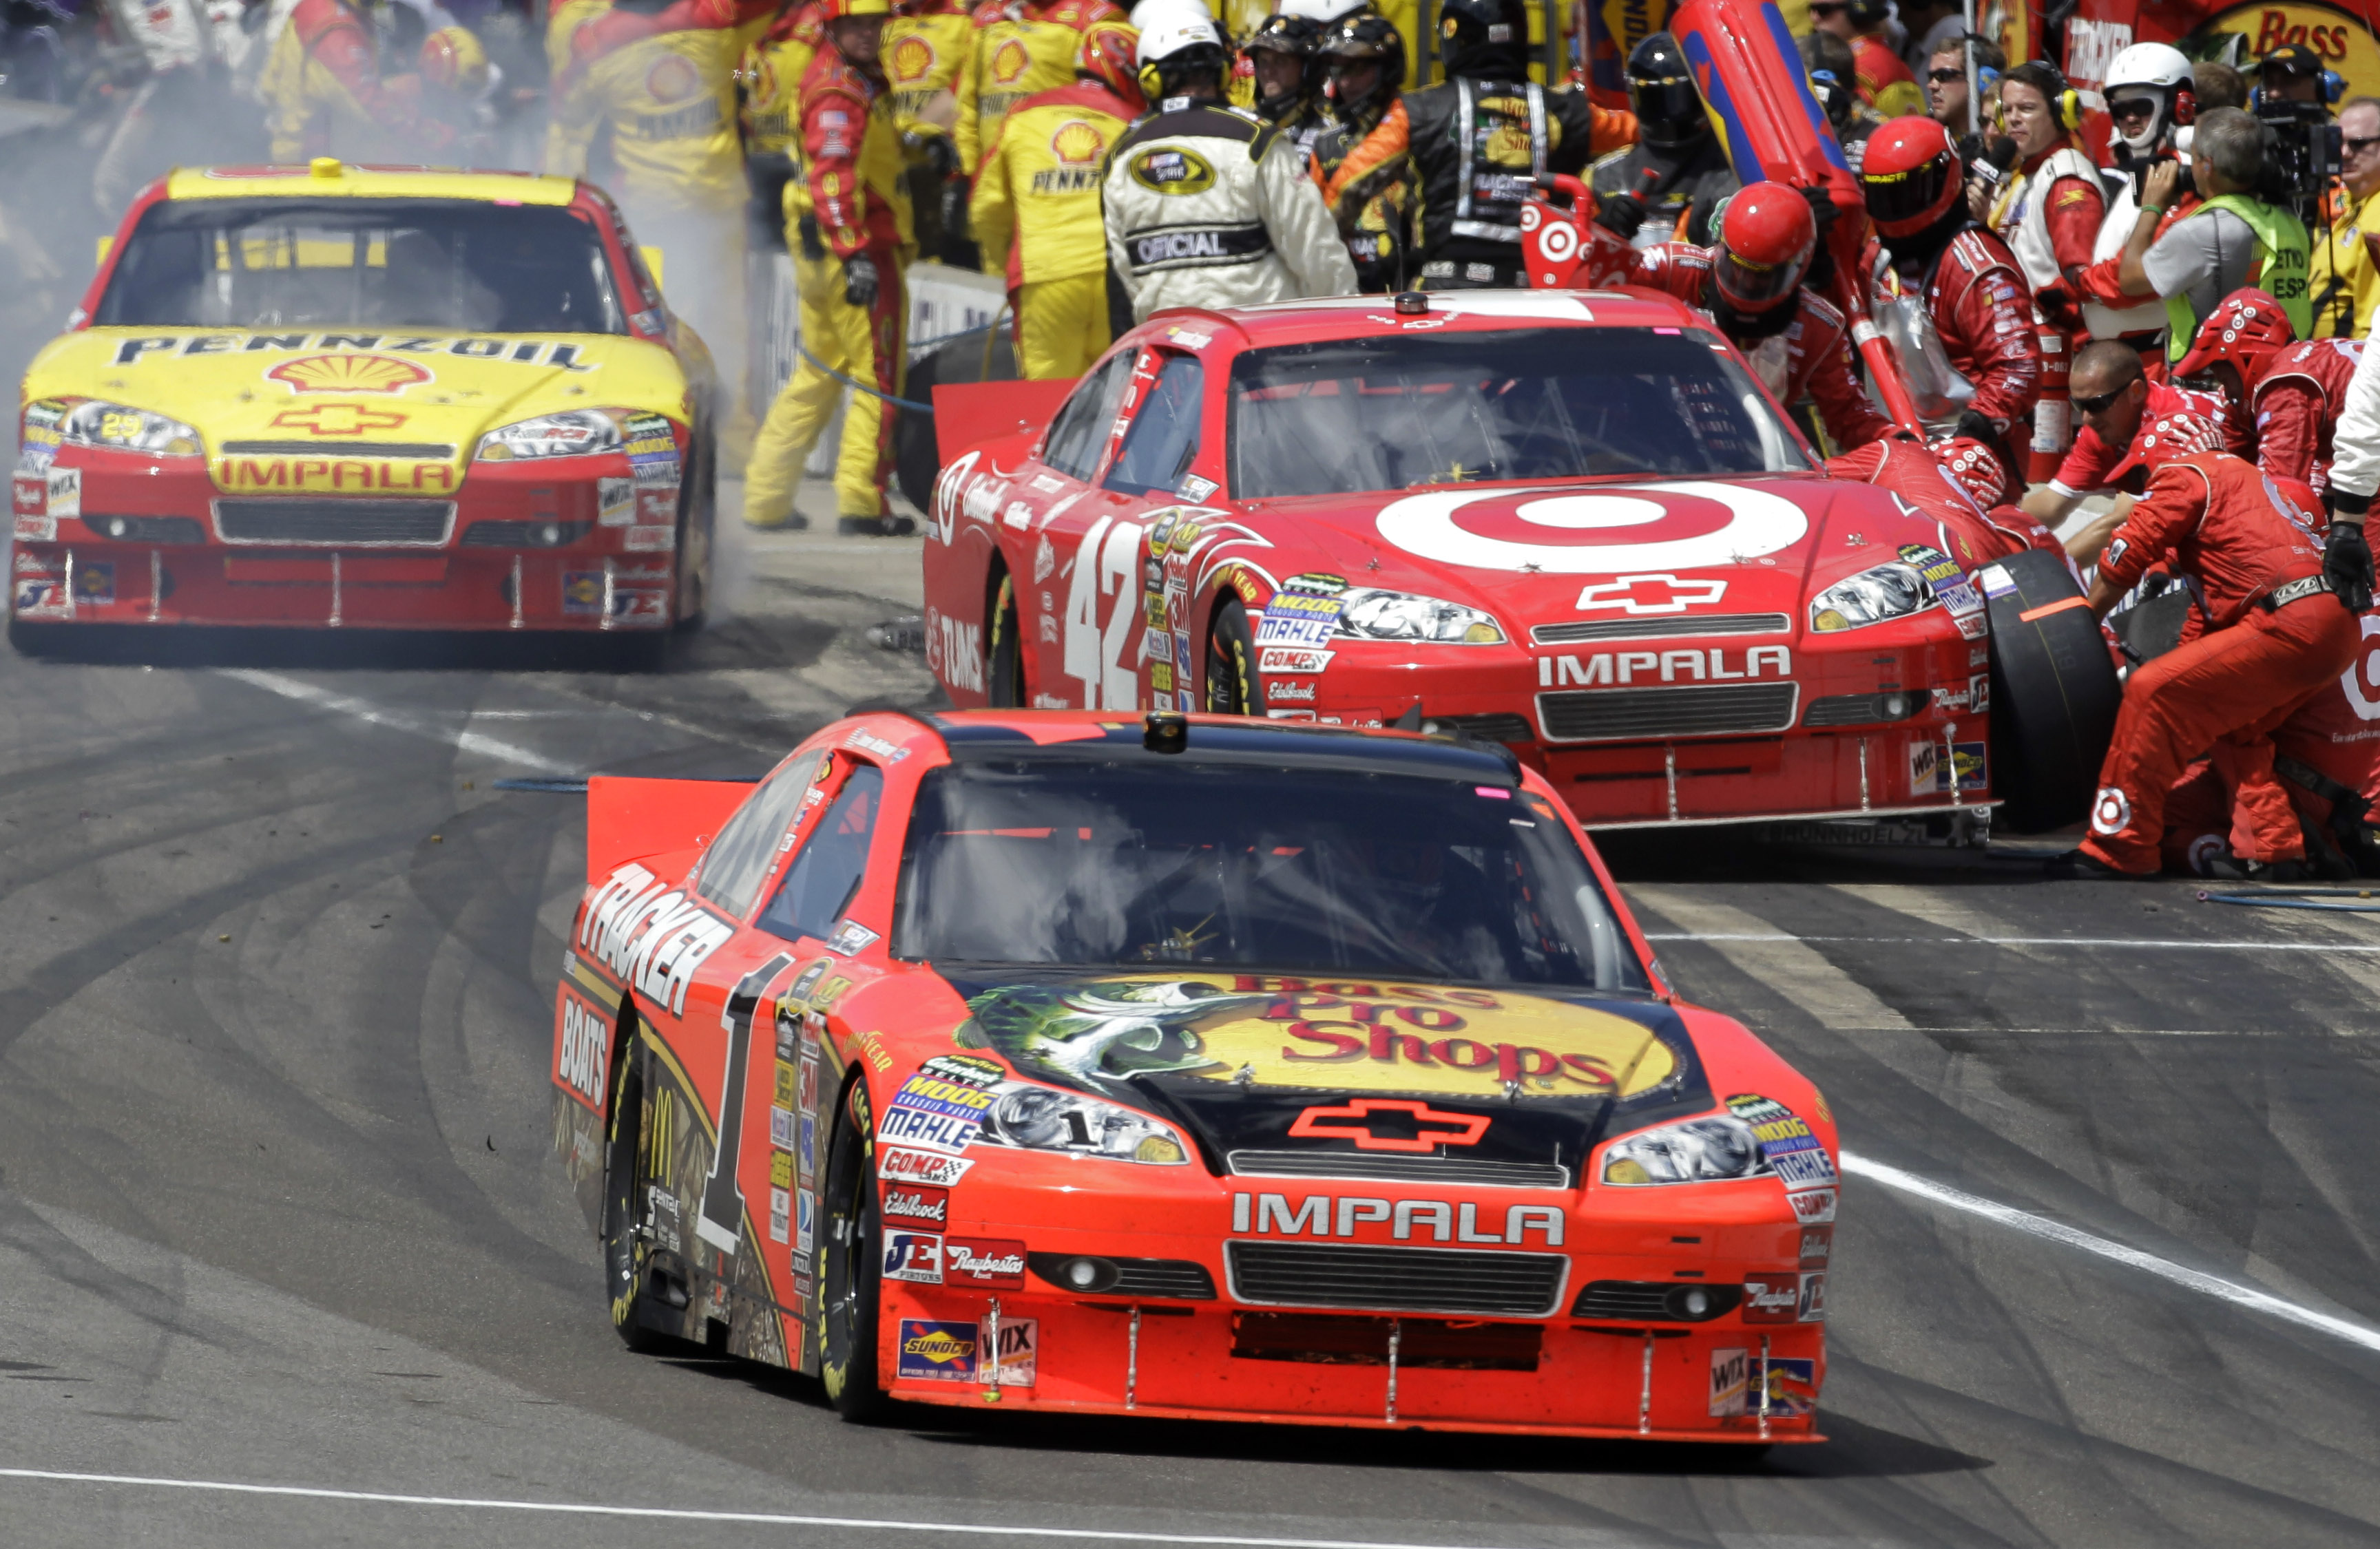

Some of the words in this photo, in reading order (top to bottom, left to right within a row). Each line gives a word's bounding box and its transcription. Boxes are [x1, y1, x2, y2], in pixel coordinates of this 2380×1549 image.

[2253, 10, 2348, 59] Bass
[2274, 278, 2306, 299] ESP
[106, 334, 601, 373] PENNZOIL
[101, 414, 142, 438] 29
[221, 460, 453, 488] IMPALA
[1064, 515, 1144, 710] 42
[1271, 593, 1343, 614] MOOG
[1257, 619, 1335, 644] MAHLE
[1264, 651, 1313, 666] COMP
[1538, 645, 1791, 686] IMPALA
[581, 863, 734, 1017] TRACKER
[1233, 974, 1499, 1010] Bass
[1261, 991, 1468, 1032] Pro
[559, 998, 607, 1107] BOATS
[1283, 1020, 1615, 1085] Shops
[901, 1076, 1000, 1110] MOOG
[920, 1067, 985, 1088] BELTS
[696, 951, 797, 1255] 1
[897, 1093, 943, 1112] CHASSIS
[946, 1104, 980, 1120] PARTS
[881, 1106, 977, 1148] MAHLE
[1060, 1109, 1100, 1148] 1
[1751, 1117, 1810, 1143] MOOG
[886, 1150, 948, 1174] COMP
[919, 1171, 949, 1183] CAMS
[1771, 1150, 1835, 1184] MAHLE
[884, 1190, 946, 1221] Edelbrock
[1232, 1192, 1565, 1245] IMPALA
[884, 1234, 937, 1274] JE
[946, 1245, 1025, 1278] Raybestos
[907, 1340, 973, 1356] SUNOCO
[982, 1323, 1032, 1360] WIX
[1711, 1353, 1746, 1393] WIX
